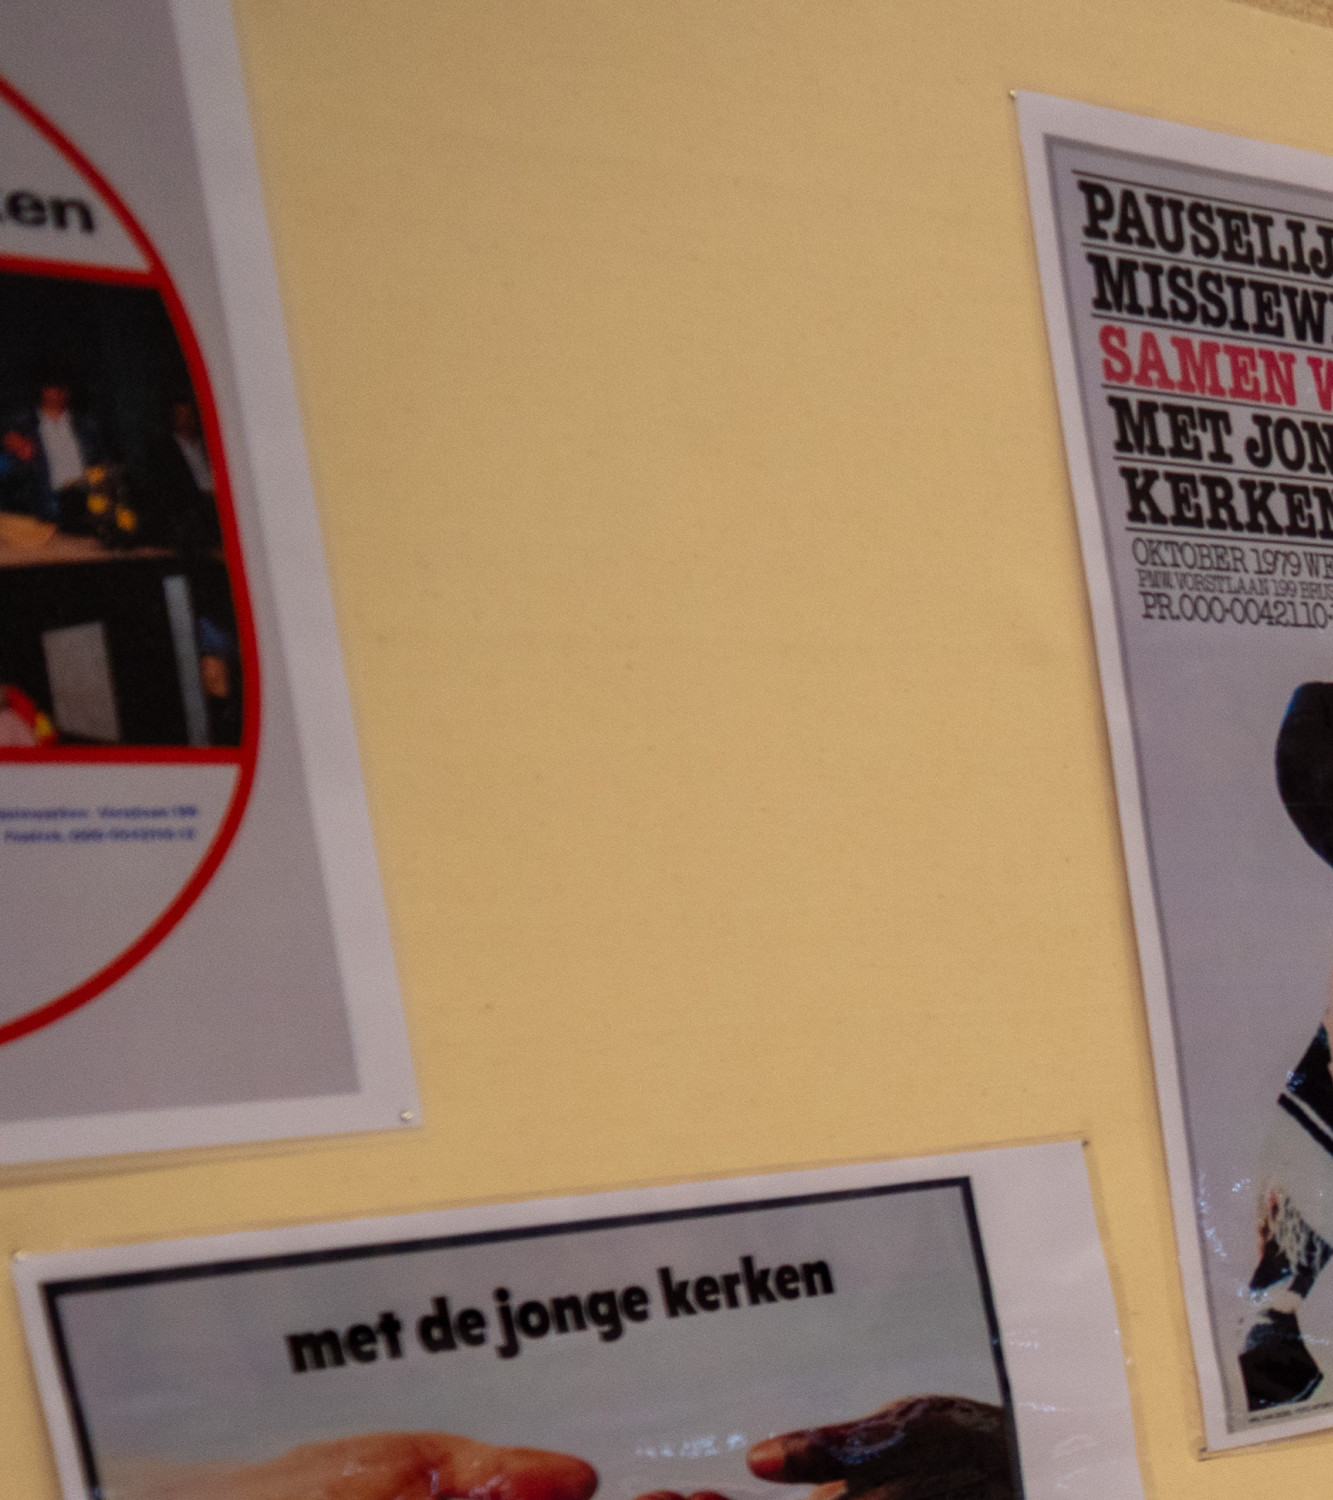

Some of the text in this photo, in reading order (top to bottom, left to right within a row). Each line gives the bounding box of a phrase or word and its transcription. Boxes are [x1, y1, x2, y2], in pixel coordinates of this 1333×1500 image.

[1100, 325, 1296, 406] SAMEN
[1107, 397, 1234, 463] MET
[1132, 537, 1247, 573] OKTOBER
[1255, 547, 1299, 577] 1979
[285, 1251, 835, 1375] met de jonge kerken
